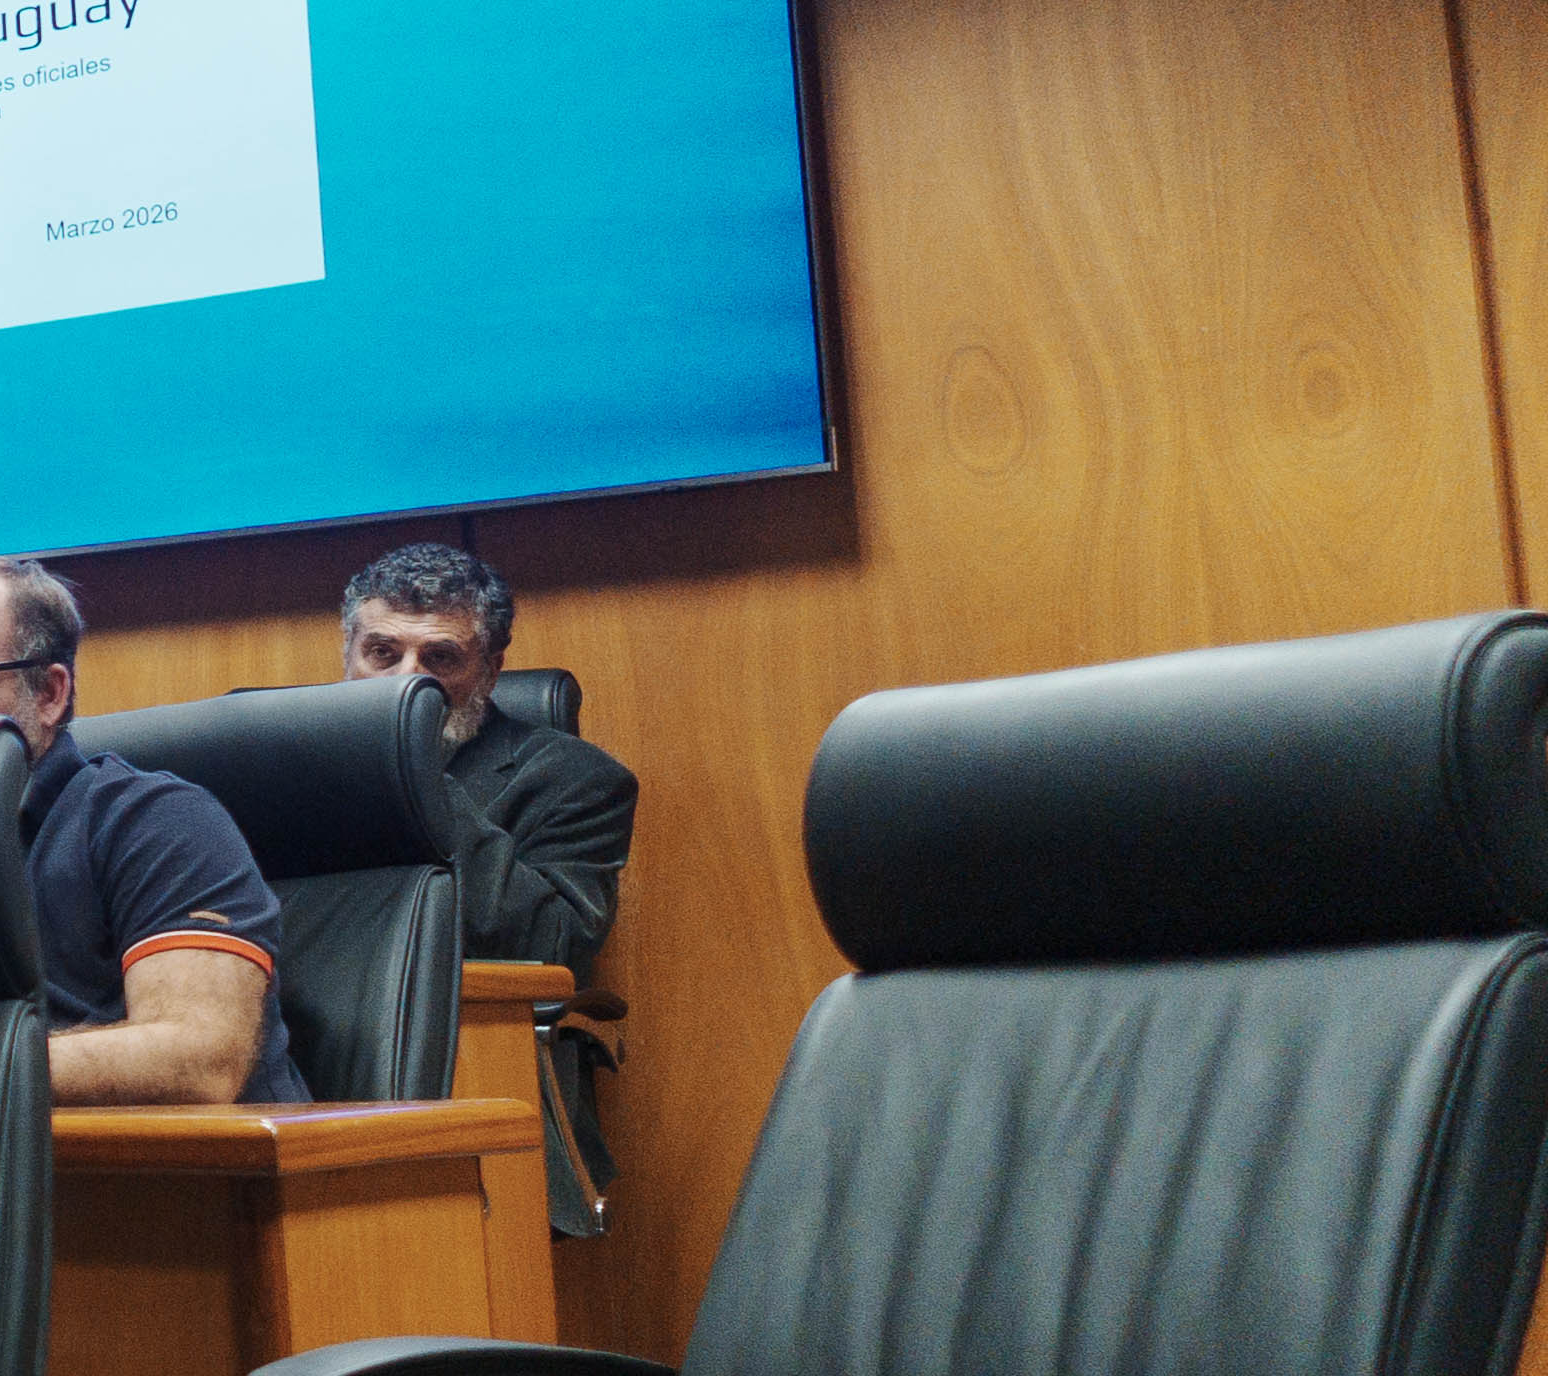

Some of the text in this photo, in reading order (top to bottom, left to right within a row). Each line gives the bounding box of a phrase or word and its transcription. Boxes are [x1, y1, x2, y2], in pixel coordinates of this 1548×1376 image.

[22, 57, 112, 88] oficiales
[46, 201, 179, 242] Marzo 2026
